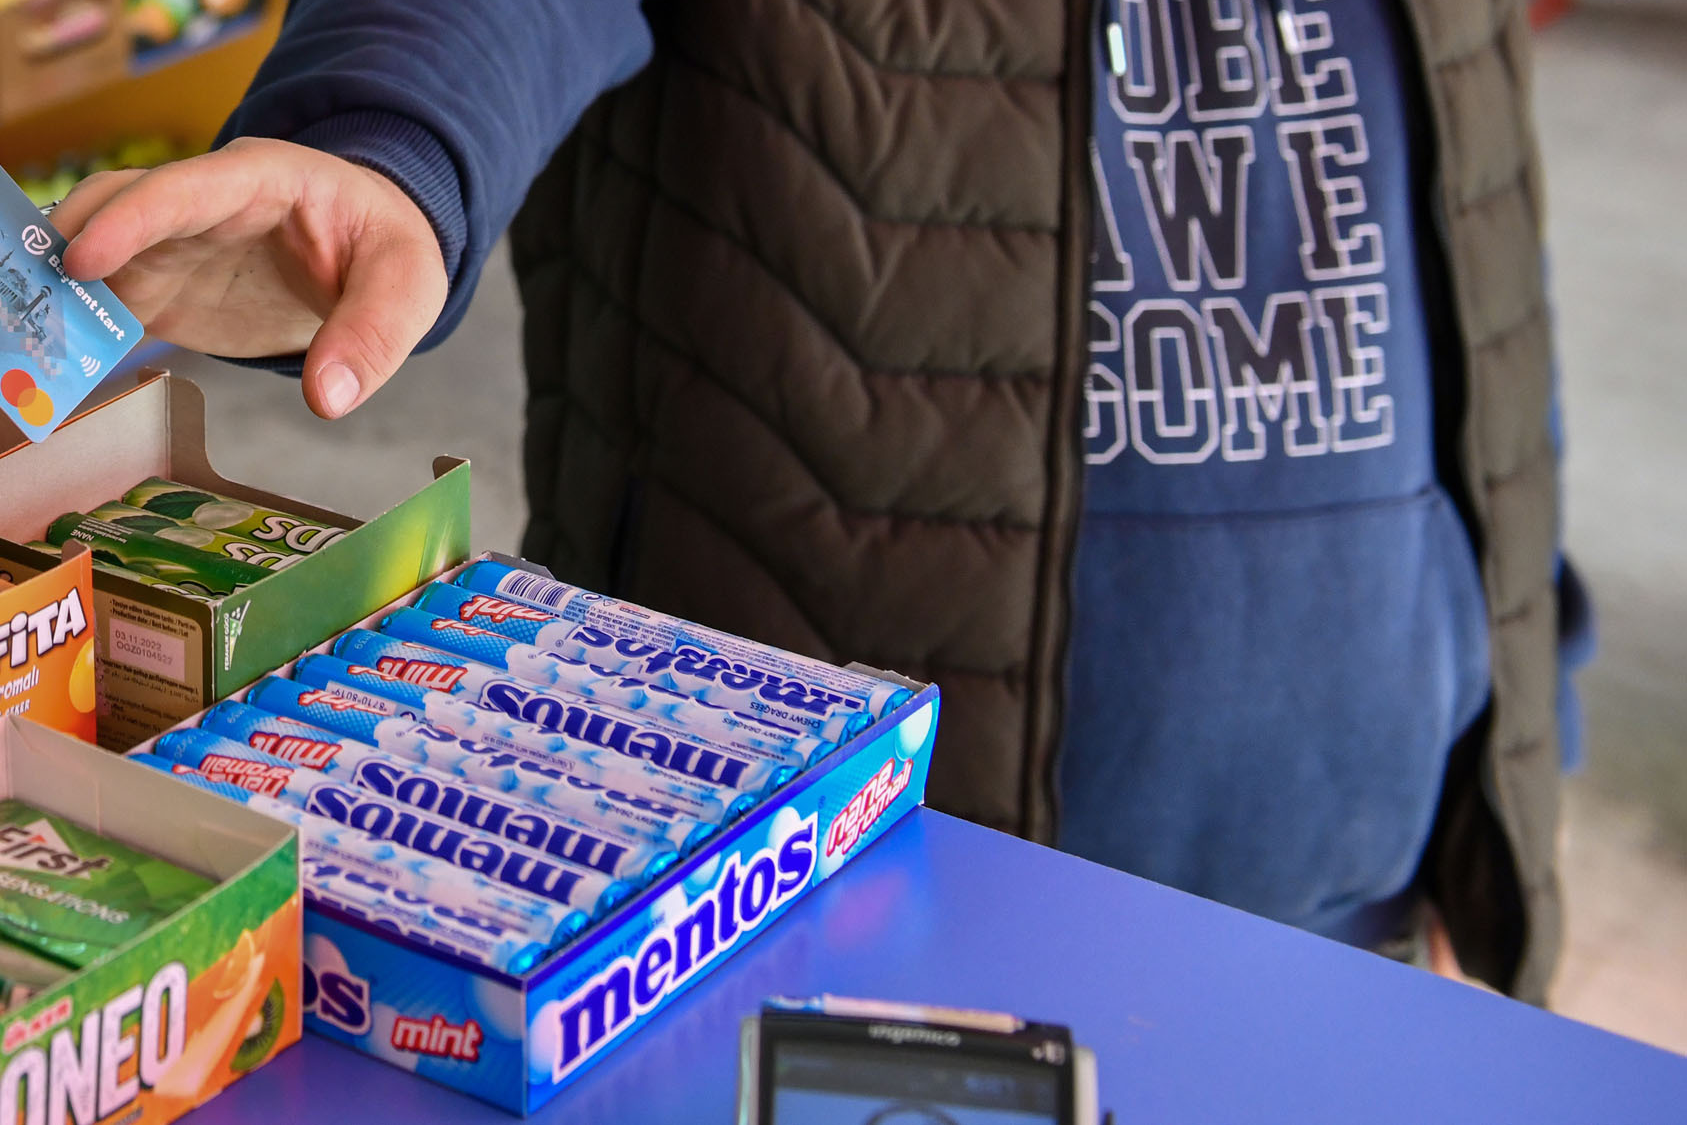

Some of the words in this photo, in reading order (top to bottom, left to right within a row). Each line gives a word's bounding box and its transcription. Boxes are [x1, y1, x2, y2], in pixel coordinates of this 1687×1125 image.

[48, 254, 98, 311] Başkent
[95, 307, 125, 341] Kart
[70, 529, 95, 542] NANE
[460, 595, 558, 623] mint
[486, 684, 750, 789] mentos
[750, 701, 789, 721] DRAGEES
[789, 713, 821, 729] CHEWY
[312, 786, 585, 906] mentos
[361, 762, 630, 876] mentos
[826, 757, 895, 857] nane
[557, 821, 815, 1069] mentos
[392, 1014, 484, 1062] mint
